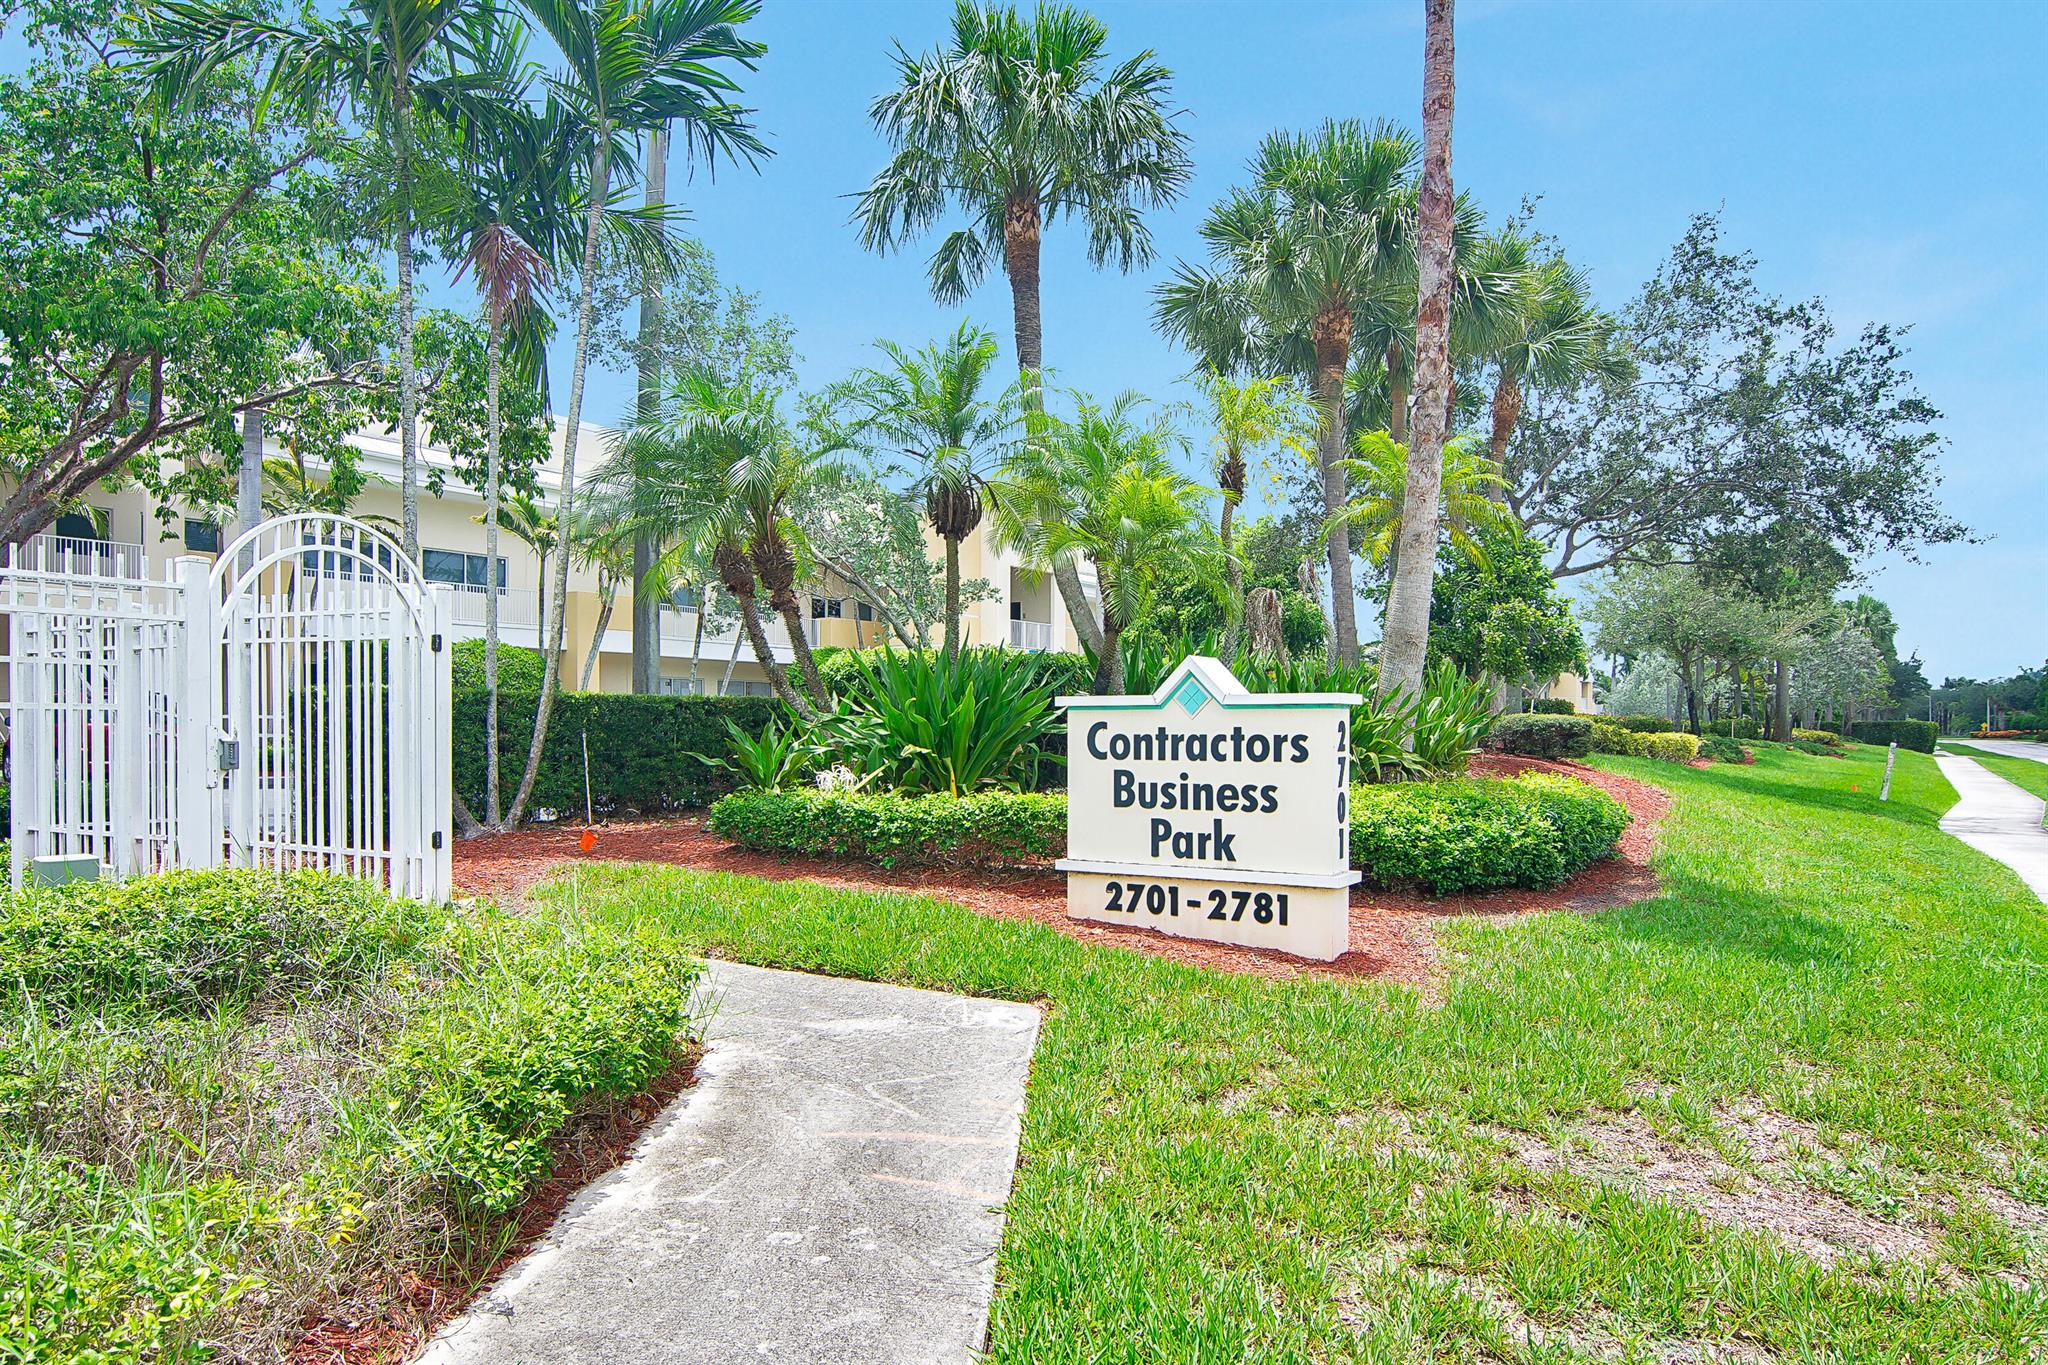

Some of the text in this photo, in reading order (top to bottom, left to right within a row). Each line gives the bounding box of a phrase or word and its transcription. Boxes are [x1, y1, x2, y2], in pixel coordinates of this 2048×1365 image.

[1086, 721, 1309, 763] Contractors
[1113, 769, 1278, 813] Business
[1337, 720, 1346, 860] 2701
[1150, 818, 1236, 861] Park
